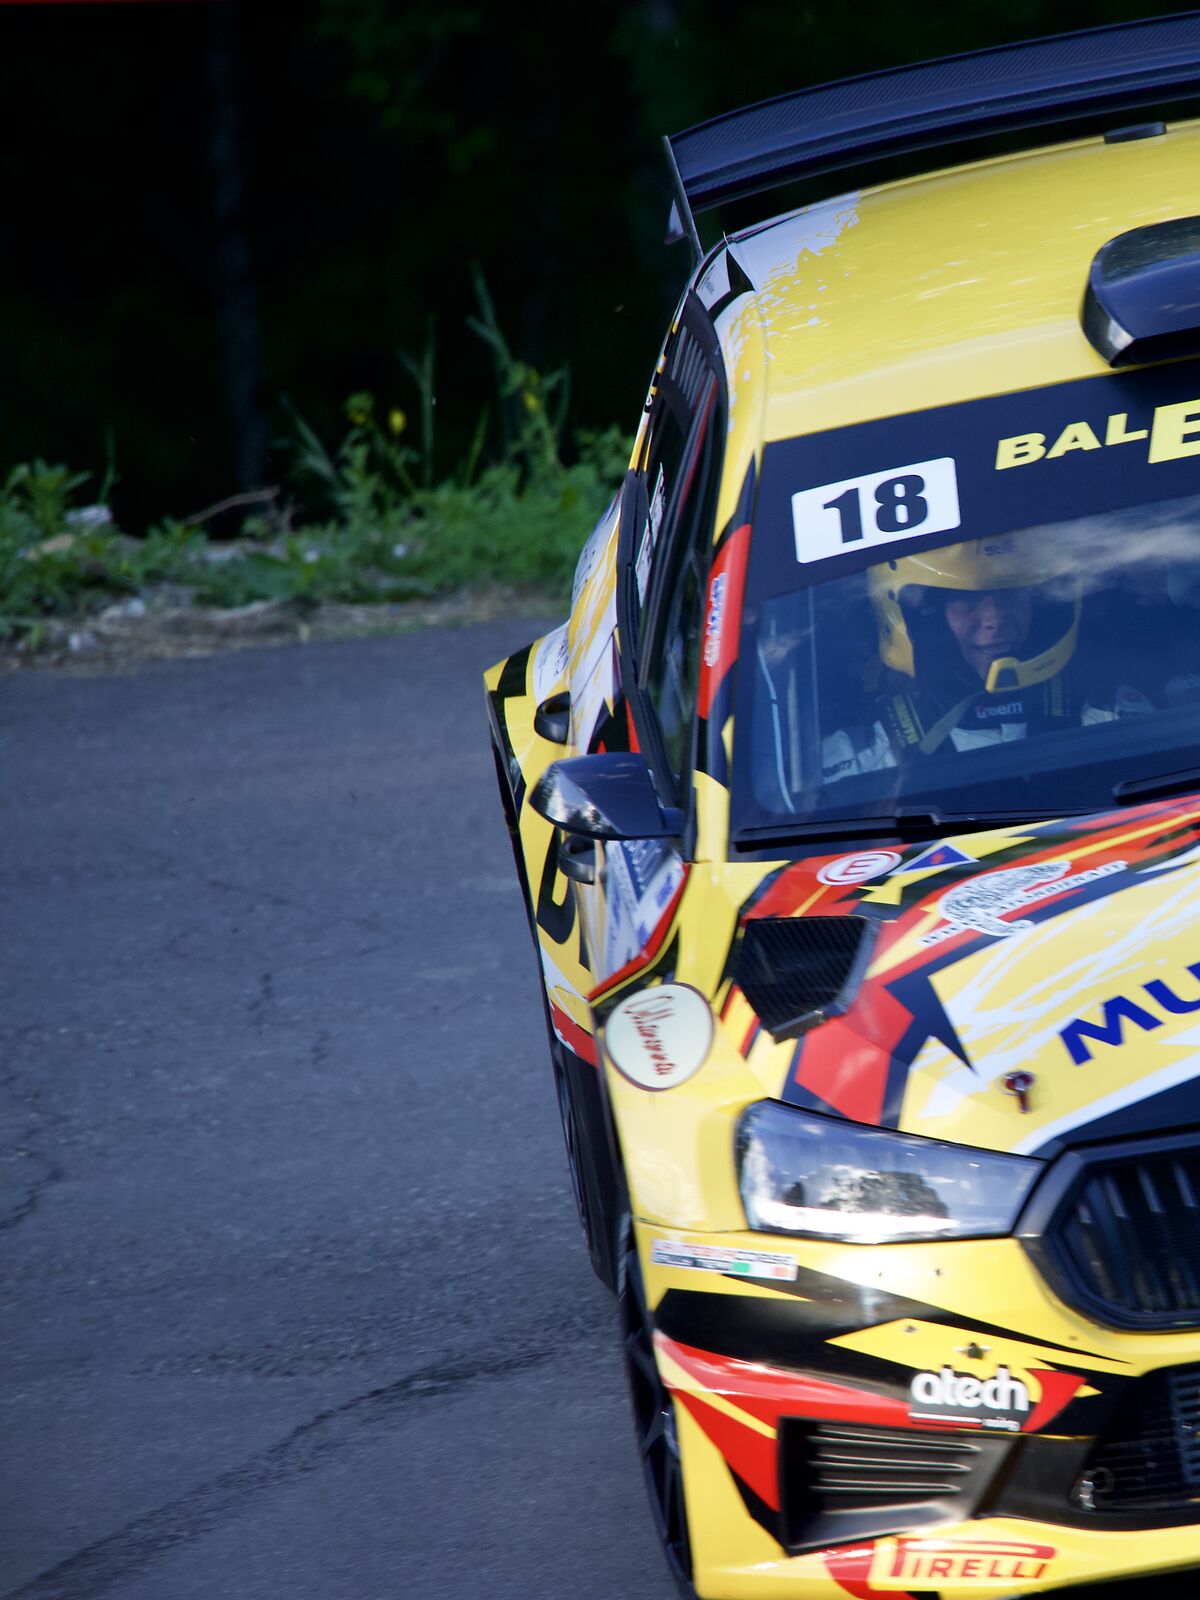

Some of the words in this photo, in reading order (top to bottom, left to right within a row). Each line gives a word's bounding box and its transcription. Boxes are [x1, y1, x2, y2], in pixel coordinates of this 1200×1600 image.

[823, 474, 930, 545] 18
[910, 1367, 1030, 1412] atech
[889, 1537, 1057, 1580] PIRELLI
